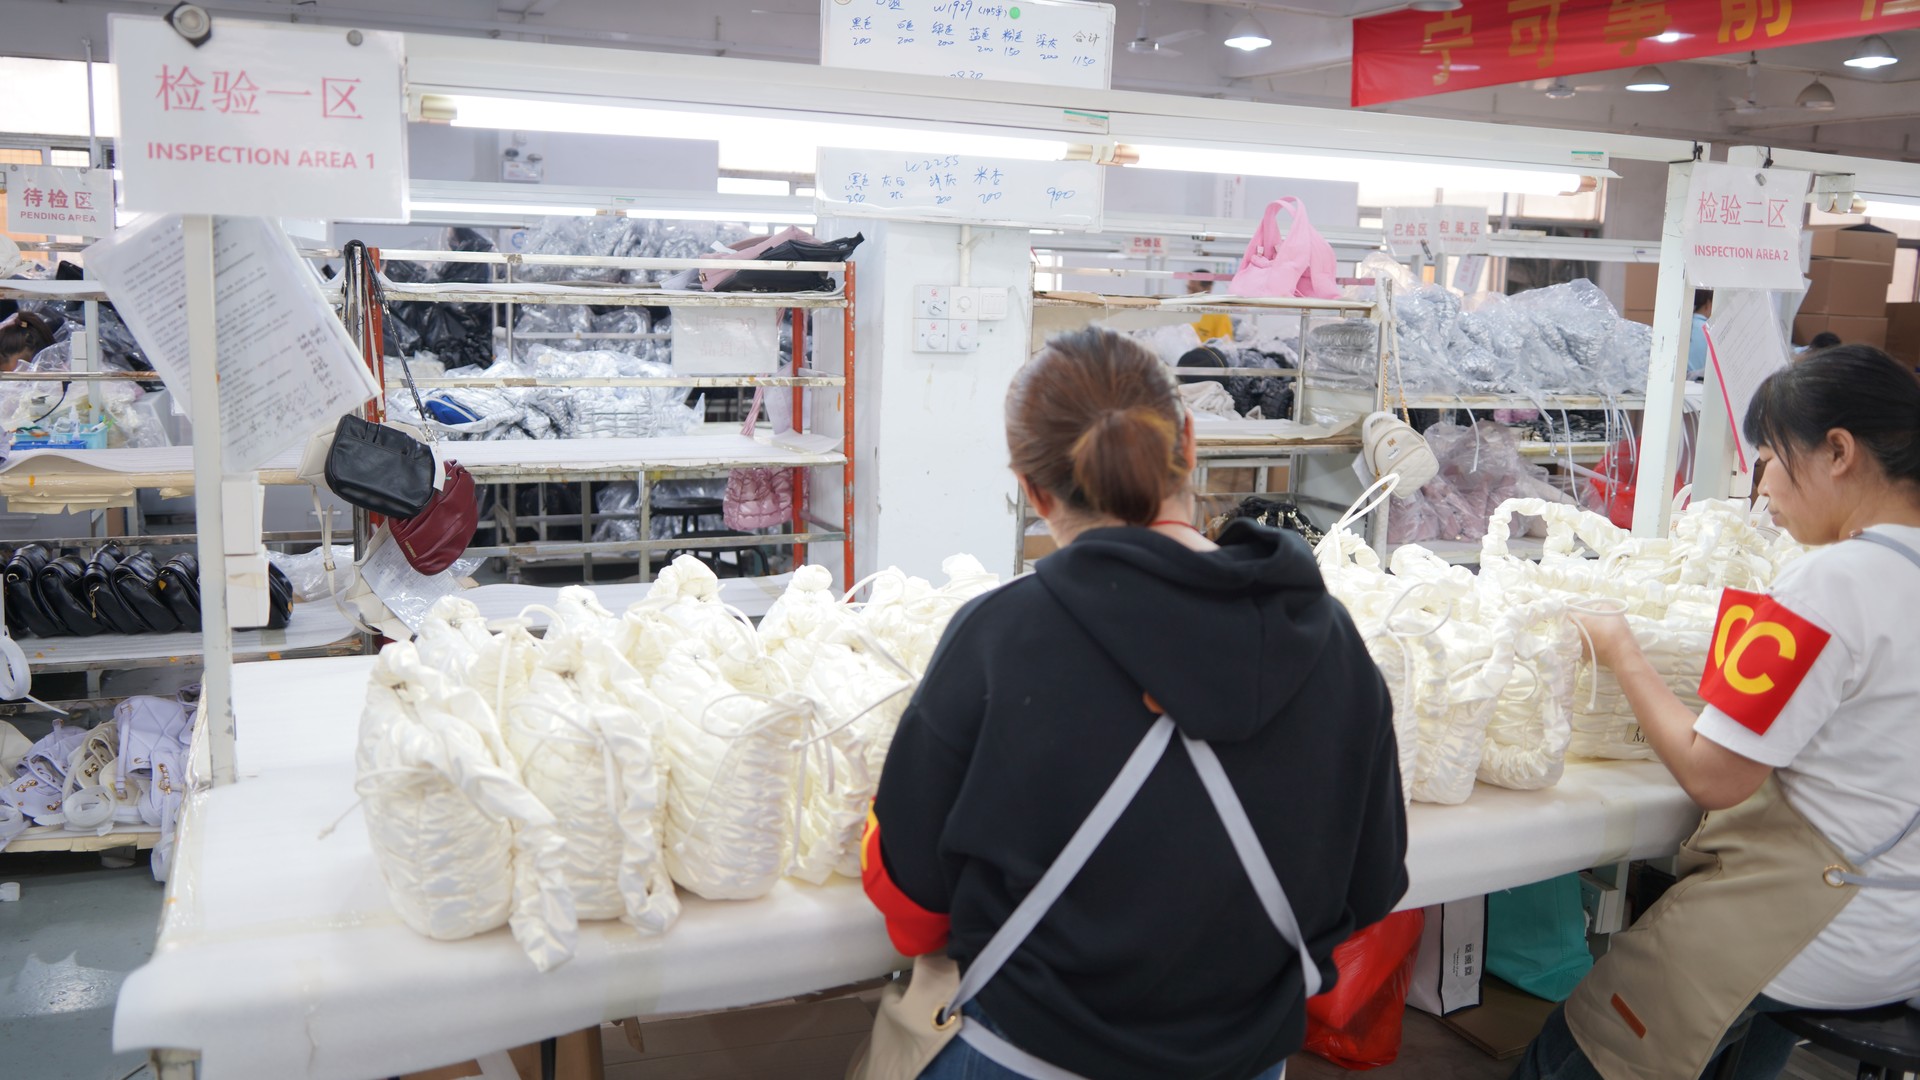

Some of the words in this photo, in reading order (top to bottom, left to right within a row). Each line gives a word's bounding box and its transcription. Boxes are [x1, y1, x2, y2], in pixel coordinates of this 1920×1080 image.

[850, 16, 872, 30] 黑色
[1073, 30, 1100, 46] 合计
[1420, 0, 1920, 86] 宁可事前
[852, 36, 872, 45] 200
[897, 36, 915, 45] 200
[1004, 47, 1021, 56] 150
[1073, 55, 1096, 67] 1150
[155, 64, 363, 119] 检验一区
[147, 142, 290, 166] INSPECTION
[297, 150, 358, 169] AREA
[366, 152, 375, 170] 1
[23, 187, 95, 210] 待检区
[978, 191, 1002, 204] 200
[1047, 187, 1076, 209] 900
[1697, 191, 1789, 228] 检验二区
[20, 211, 66, 220] PENDING
[67, 213, 97, 222] AREA
[1440, 220, 1480, 235] 包装区
[1694, 244, 1753, 259] INSPECTION
[1756, 247, 1781, 261] AREA
[1783, 249, 1789, 261] 2
